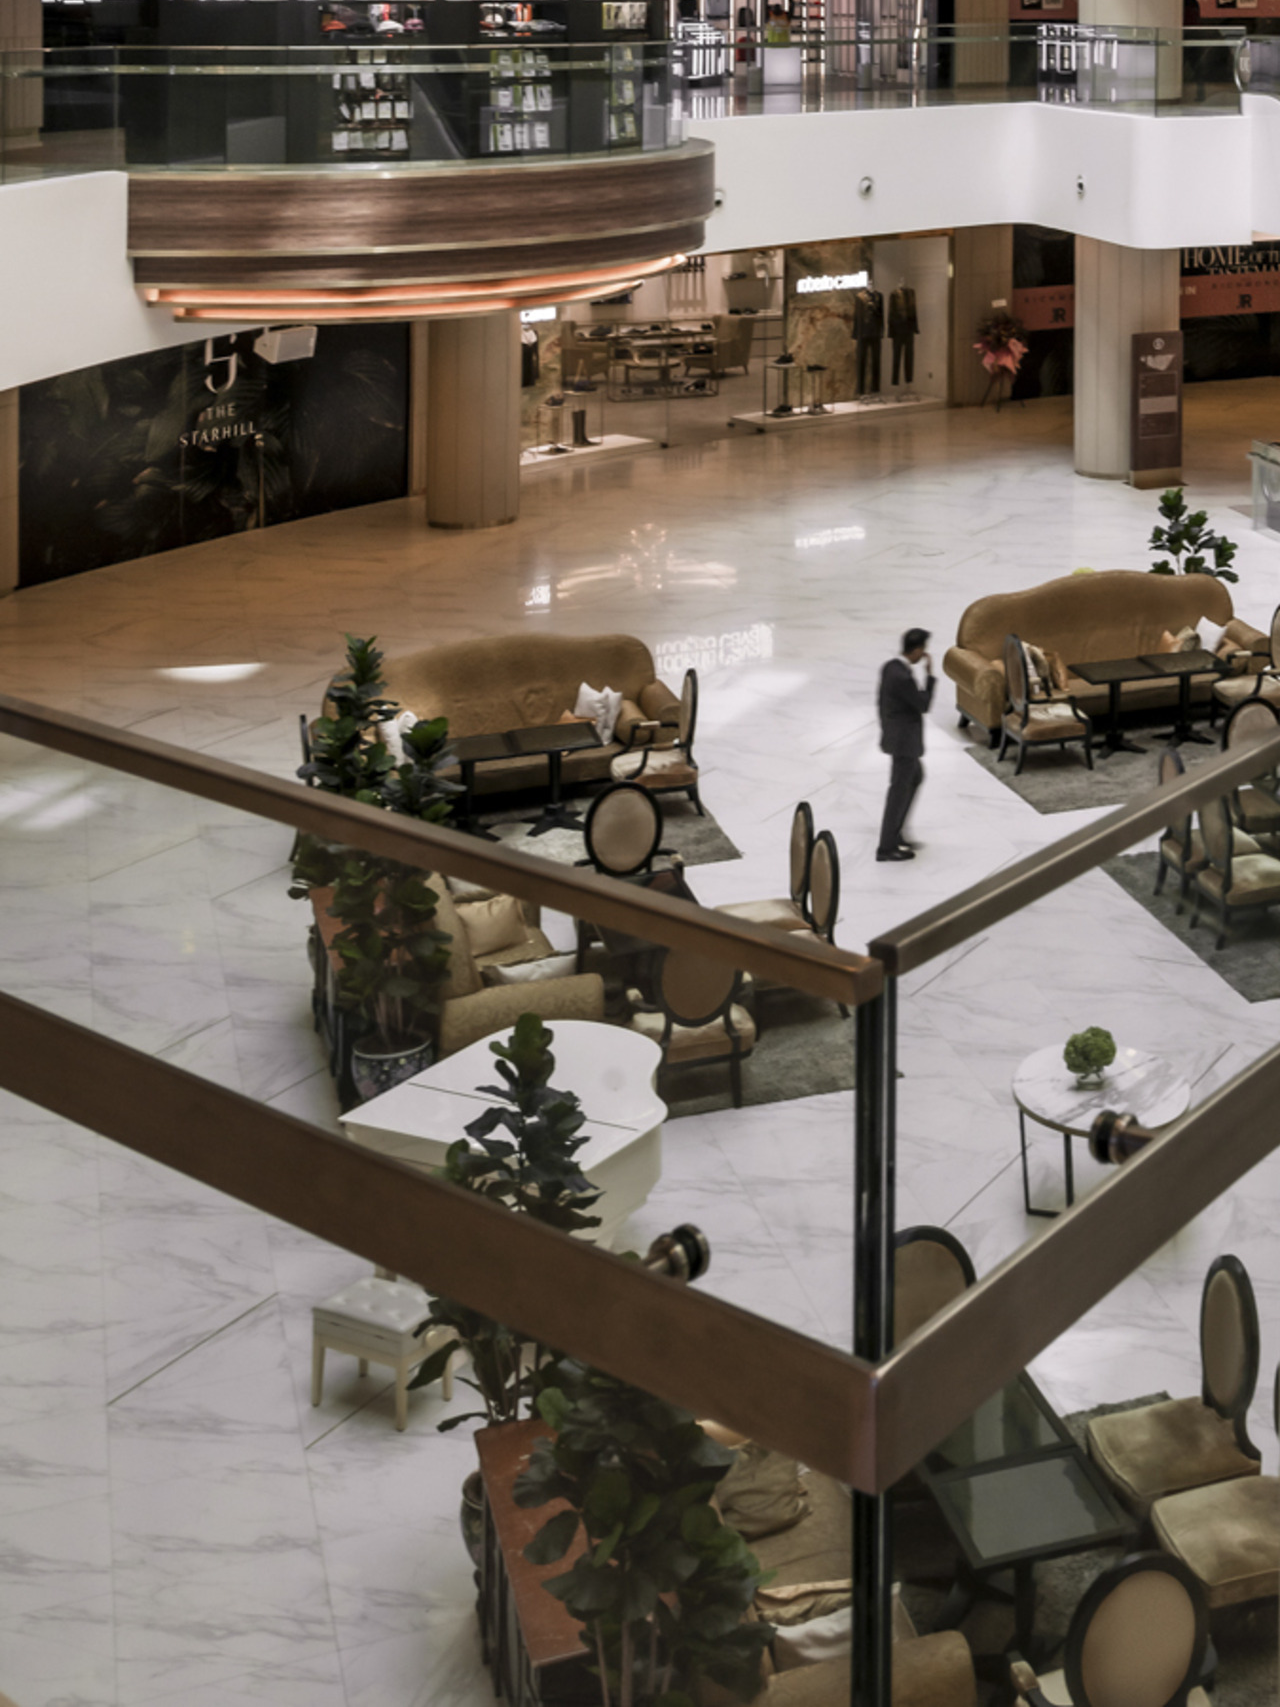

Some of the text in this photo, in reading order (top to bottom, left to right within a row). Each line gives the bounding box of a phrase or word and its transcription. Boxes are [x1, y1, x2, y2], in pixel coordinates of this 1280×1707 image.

[1183, 246, 1248, 269] HOME
[206, 402, 236, 421] THE
[179, 421, 257, 447] STARHILL
